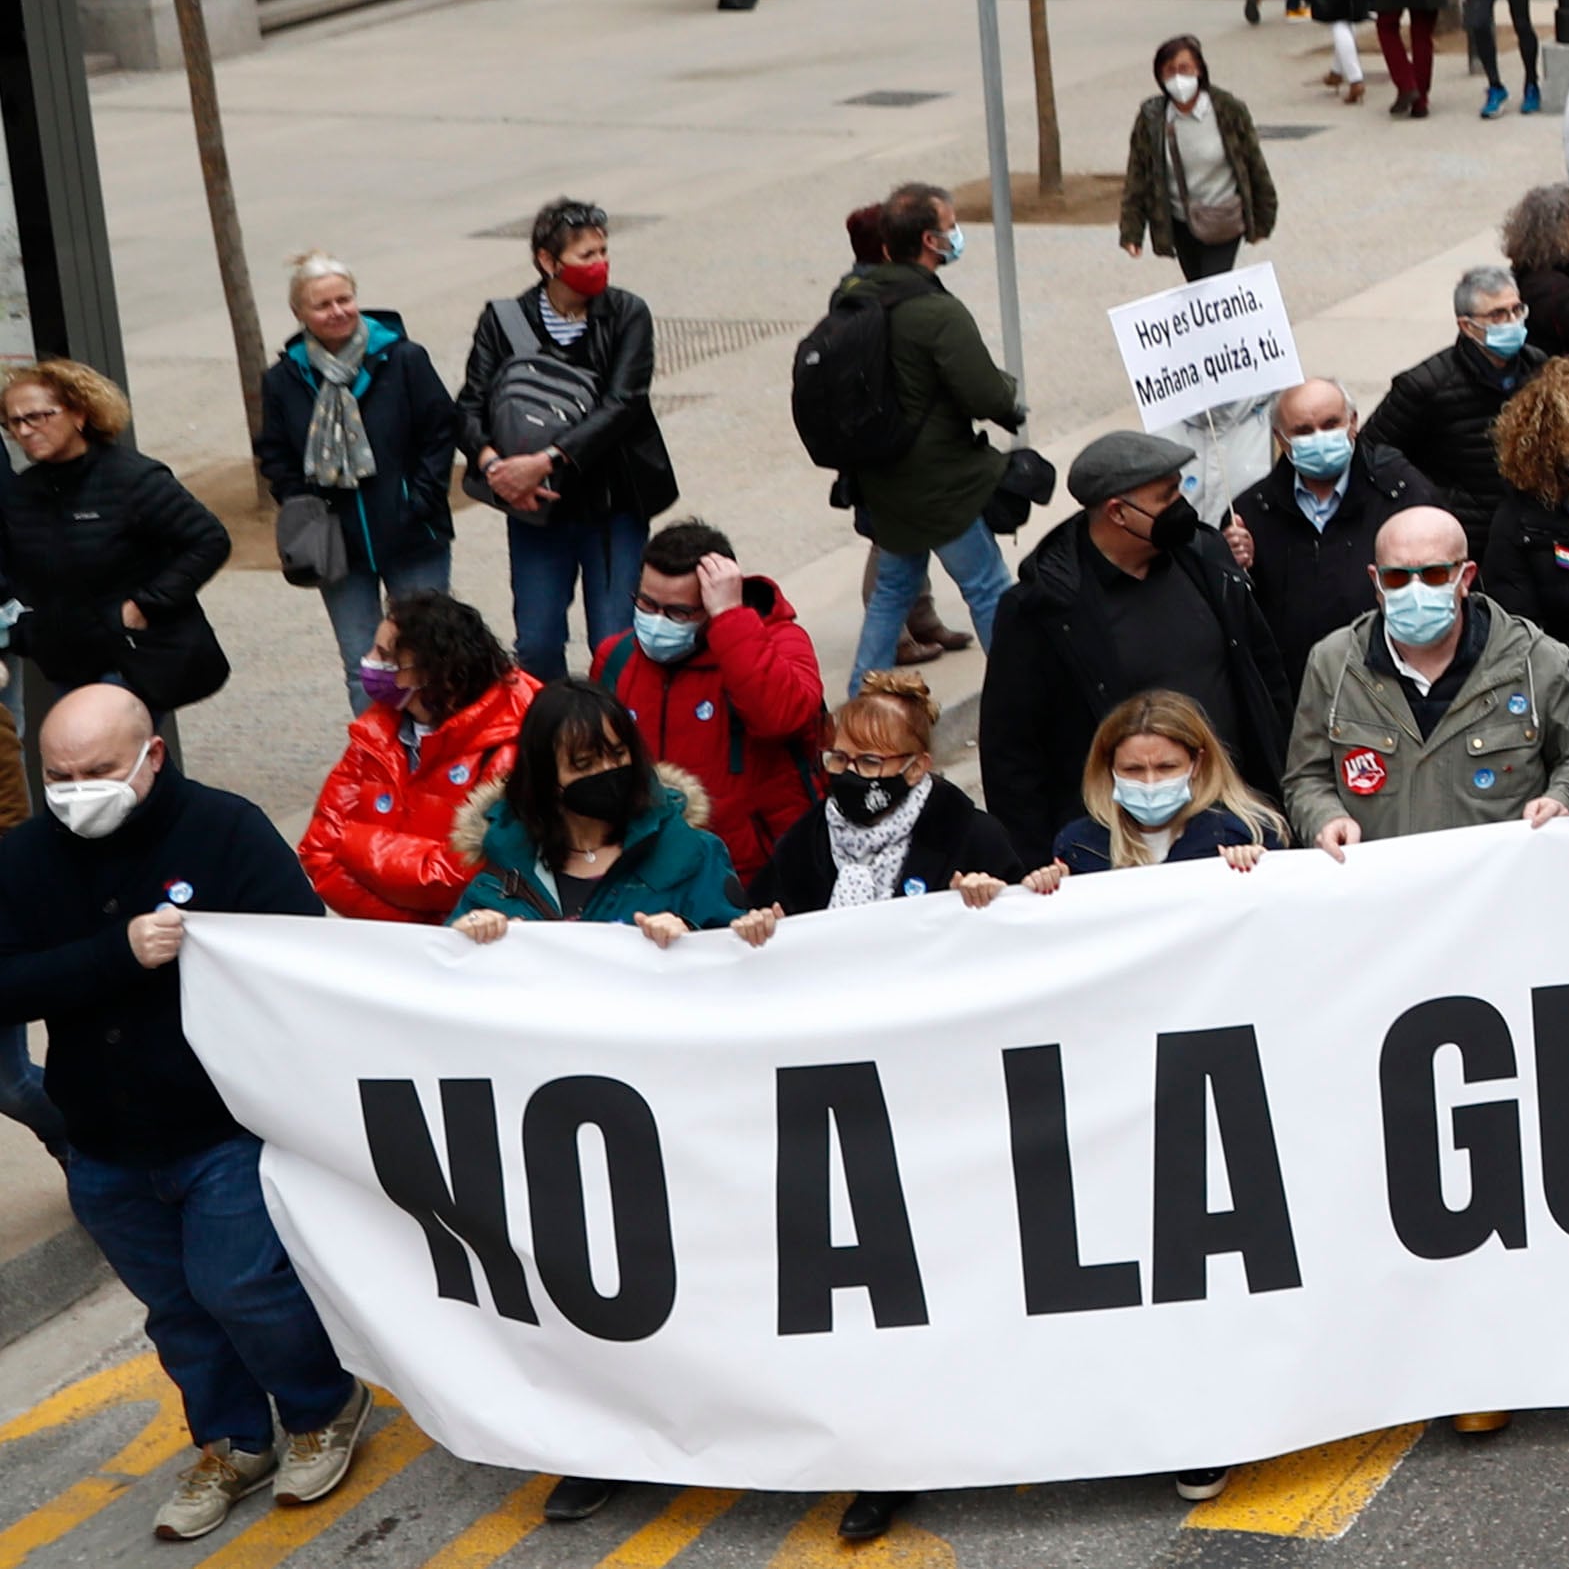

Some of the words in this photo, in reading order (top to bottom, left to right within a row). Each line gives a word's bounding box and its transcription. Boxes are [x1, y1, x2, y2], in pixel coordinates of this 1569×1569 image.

[1134, 318, 1172, 350] Hoy
[1173, 310, 1190, 336] es
[1189, 286, 1263, 328] Ucrania.
[1203, 337, 1259, 383] quizá,
[1259, 329, 1286, 362] tú.
[358, 1074, 677, 1343] NO
[775, 1060, 931, 1336] A
[1000, 1023, 1304, 1316] LA
